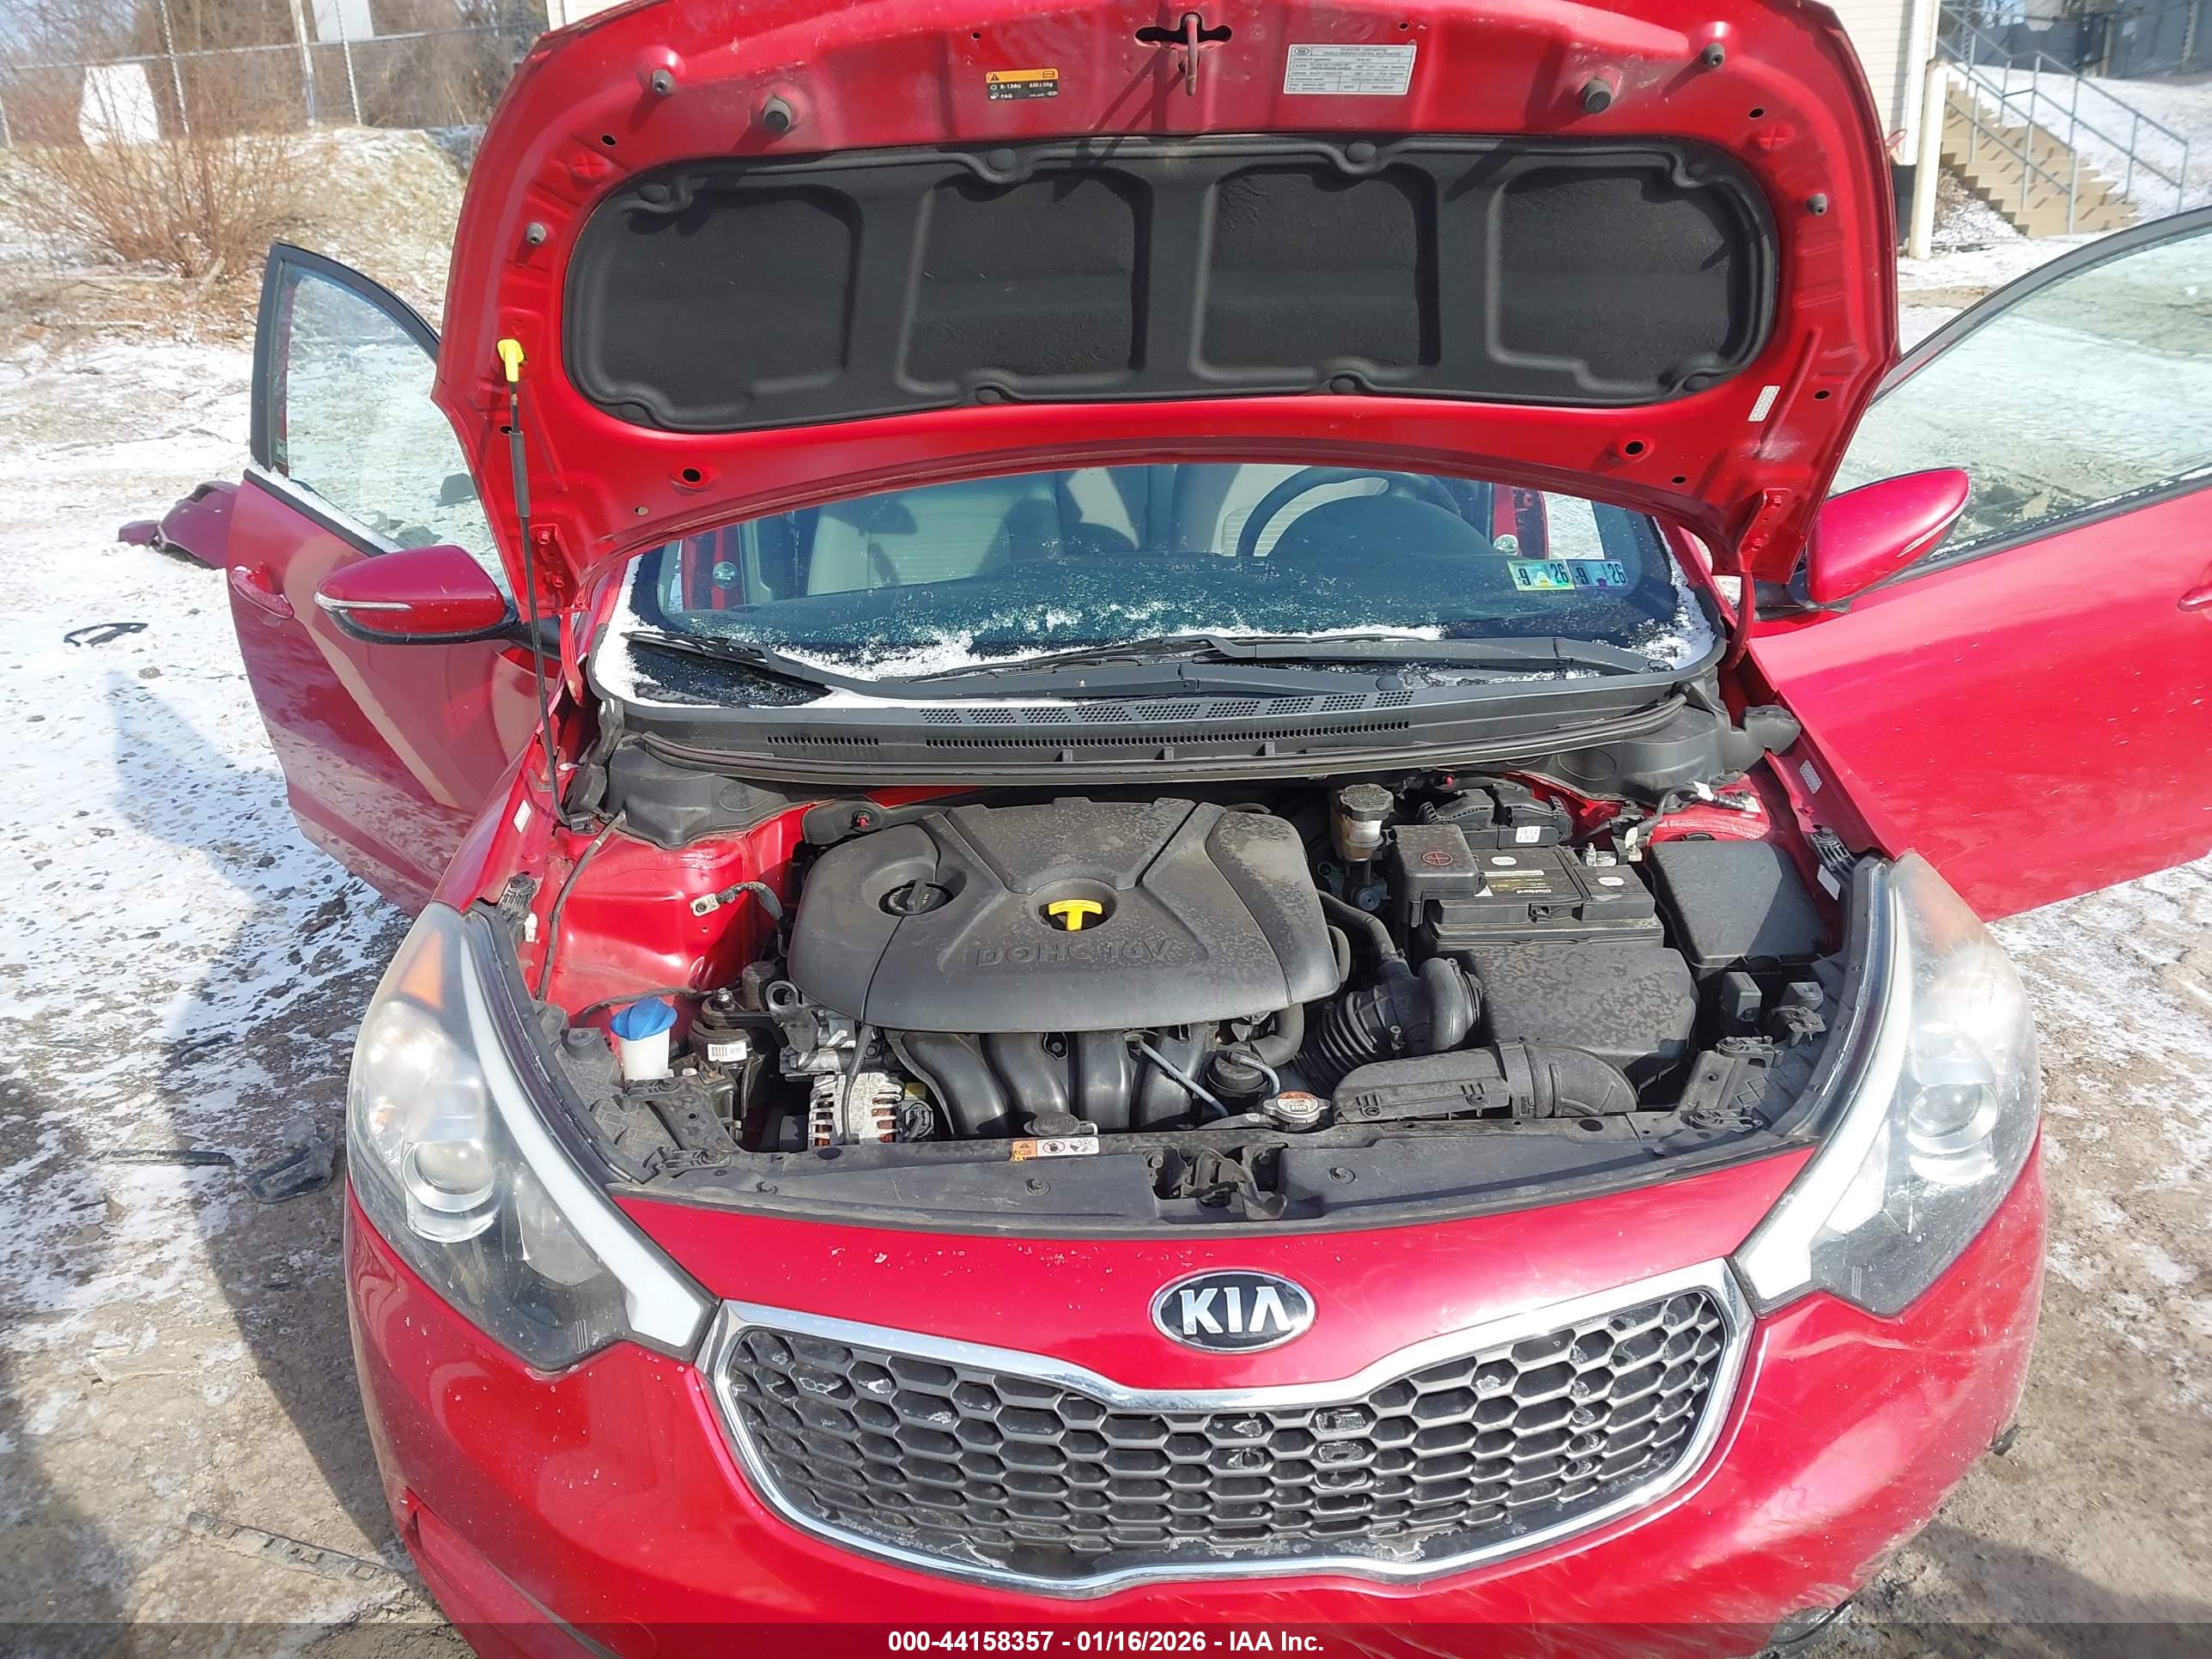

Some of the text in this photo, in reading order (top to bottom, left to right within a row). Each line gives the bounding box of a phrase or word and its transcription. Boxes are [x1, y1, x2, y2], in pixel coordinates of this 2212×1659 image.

[1518, 563, 1569, 586] 9 26
[1607, 563, 1626, 584] 26
[975, 940, 1170, 967] DOHC 16V
[1179, 1286, 1291, 1335] KIA
